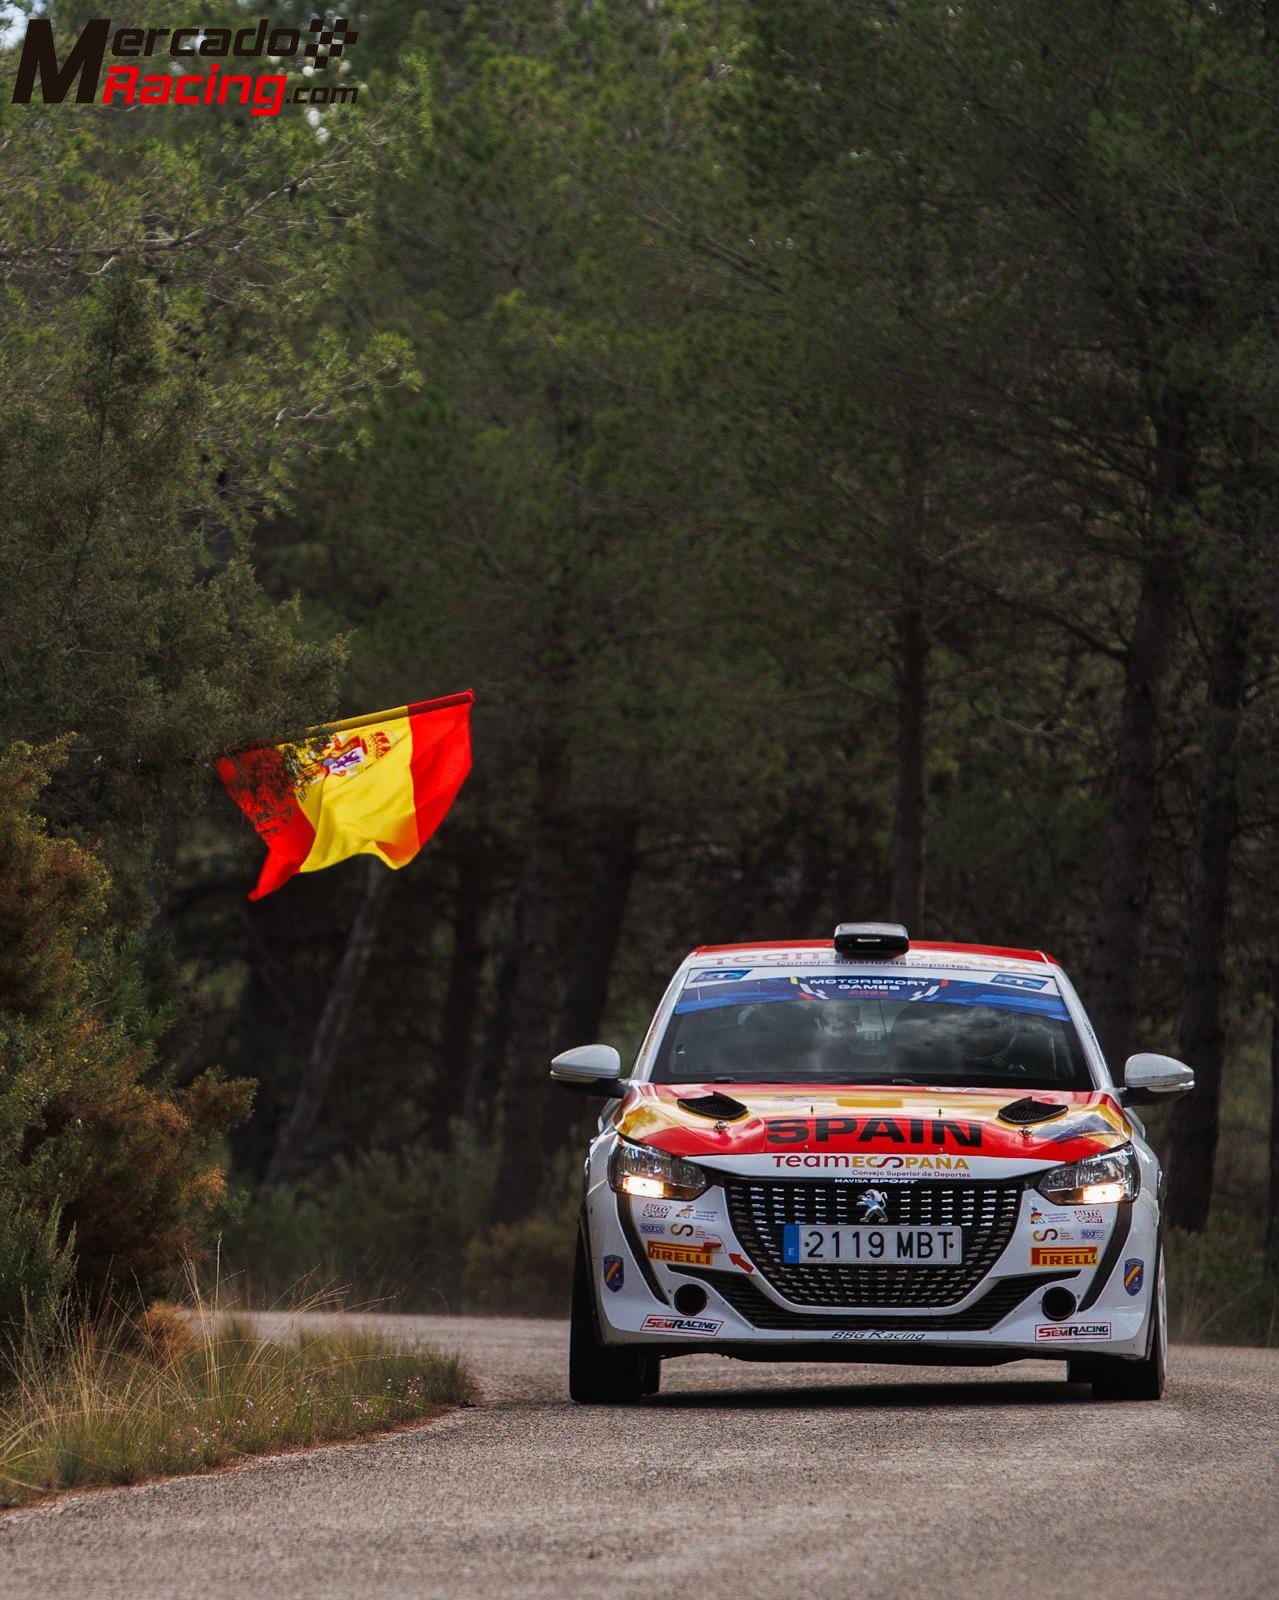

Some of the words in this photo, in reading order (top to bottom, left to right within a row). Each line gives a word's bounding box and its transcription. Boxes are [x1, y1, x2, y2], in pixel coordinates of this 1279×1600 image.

[810, 978, 929, 987] MOTORSPORT
[766, 1117, 983, 1148] SPAIN
[851, 1169, 884, 1177] Consejo
[887, 1170, 920, 1178] Superior
[647, 1241, 713, 1265] PIRELLI
[807, 1231, 885, 1258] 2119
[897, 1231, 953, 1259] MBT
